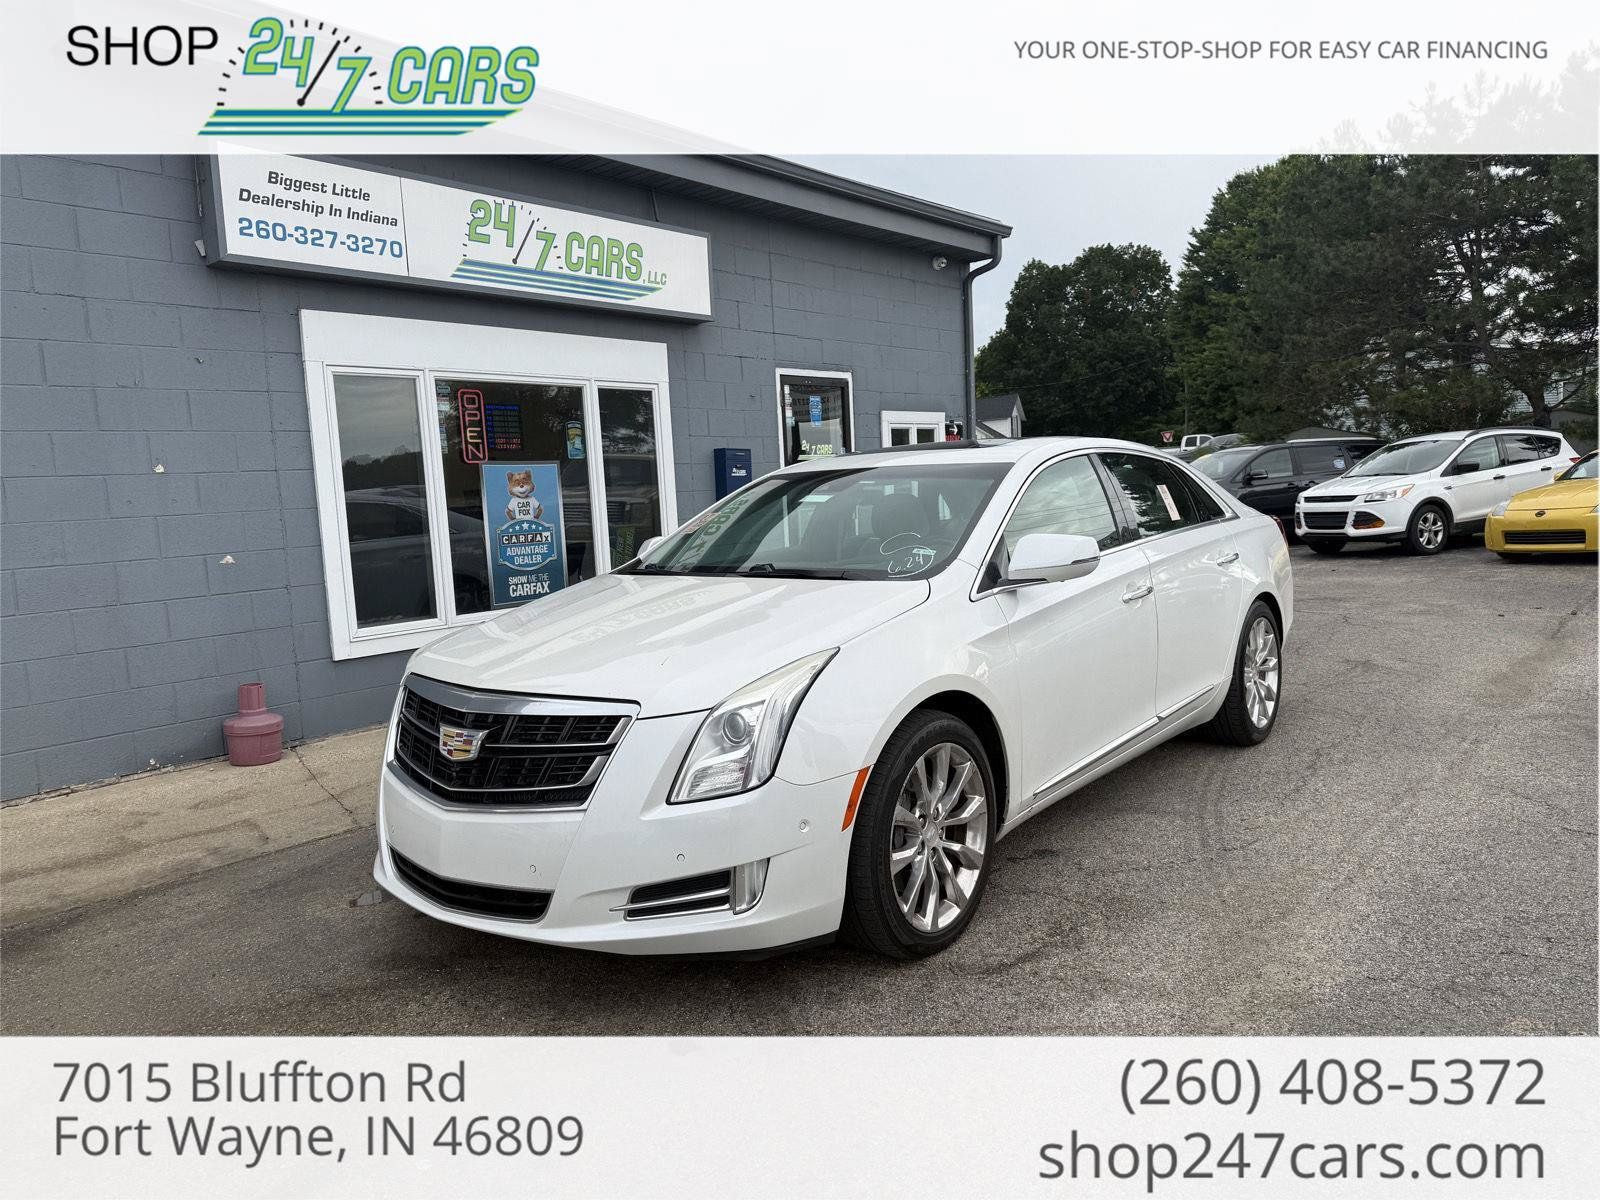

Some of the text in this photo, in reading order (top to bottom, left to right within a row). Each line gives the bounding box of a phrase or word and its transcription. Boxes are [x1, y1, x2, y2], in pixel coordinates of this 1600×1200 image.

[267, 170, 371, 202] Biggest Little
[238, 187, 399, 227] Dealership In Indiana
[237, 216, 404, 259] 260-327-3270
[463, 394, 485, 460] OPEN
[516, 501, 531, 509] CAR
[502, 532, 551, 544] CARFAX
[506, 544, 549, 556] ADVANTAGE
[514, 554, 543, 565] DEALER
[508, 574, 528, 585] SHOW
[509, 581, 551, 597] CARFAX
